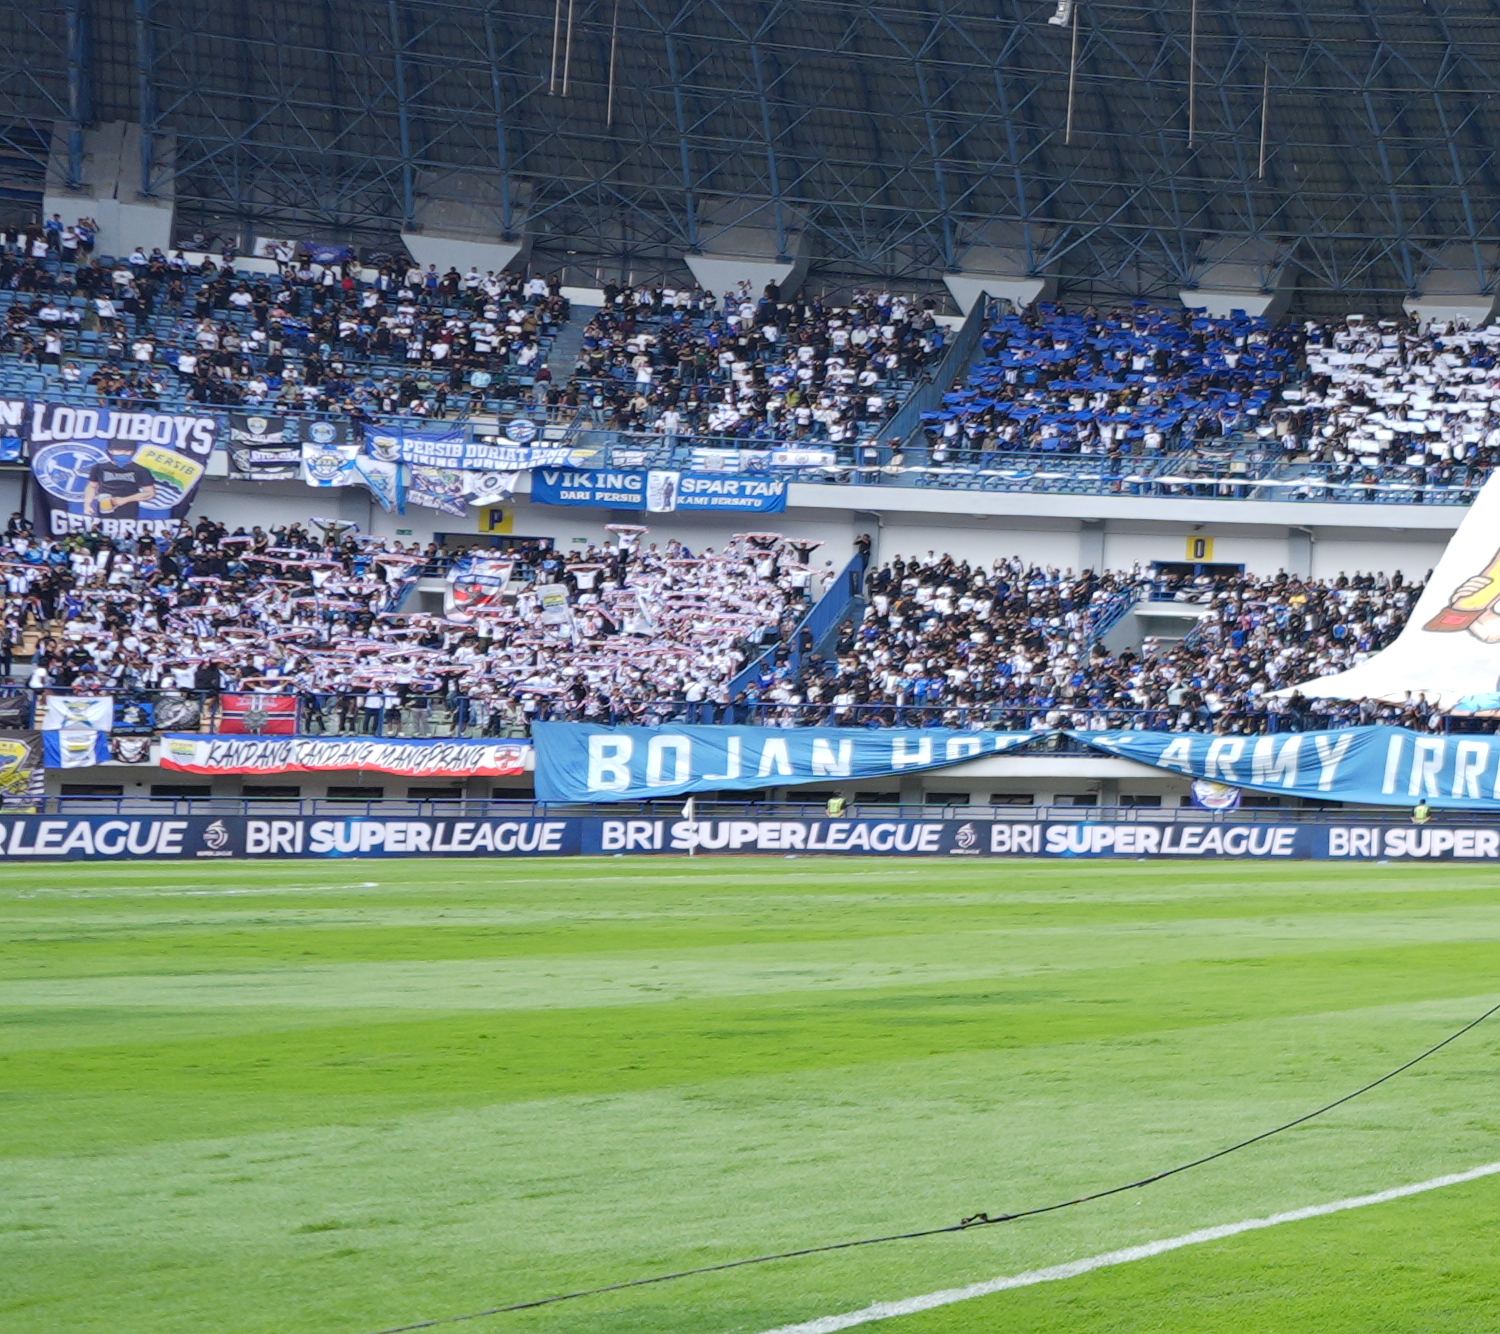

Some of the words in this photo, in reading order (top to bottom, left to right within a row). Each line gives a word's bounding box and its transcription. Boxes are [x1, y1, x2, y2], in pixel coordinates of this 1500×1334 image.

[31, 403, 215, 455] LODJIBOYS
[403, 440, 462, 457] PERSIB
[466, 444, 528, 460] DURIAT
[403, 453, 457, 467] VIKING
[543, 471, 641, 489] VIKING
[681, 478, 784, 497] SPARTAN
[560, 491, 591, 501] DARI
[595, 492, 641, 503] PERSIB
[678, 496, 707, 505] KAMI
[710, 497, 763, 507] BERSATU
[489, 509, 503, 530] P
[587, 734, 853, 792] BOJAN
[1157, 734, 1355, 792] ARMY
[0, 820, 189, 856] LEAGUE
[245, 820, 303, 854] BRI
[602, 820, 662, 852] BRI
[990, 823, 1041, 854] BRI
[1328, 827, 1378, 857] BRI
